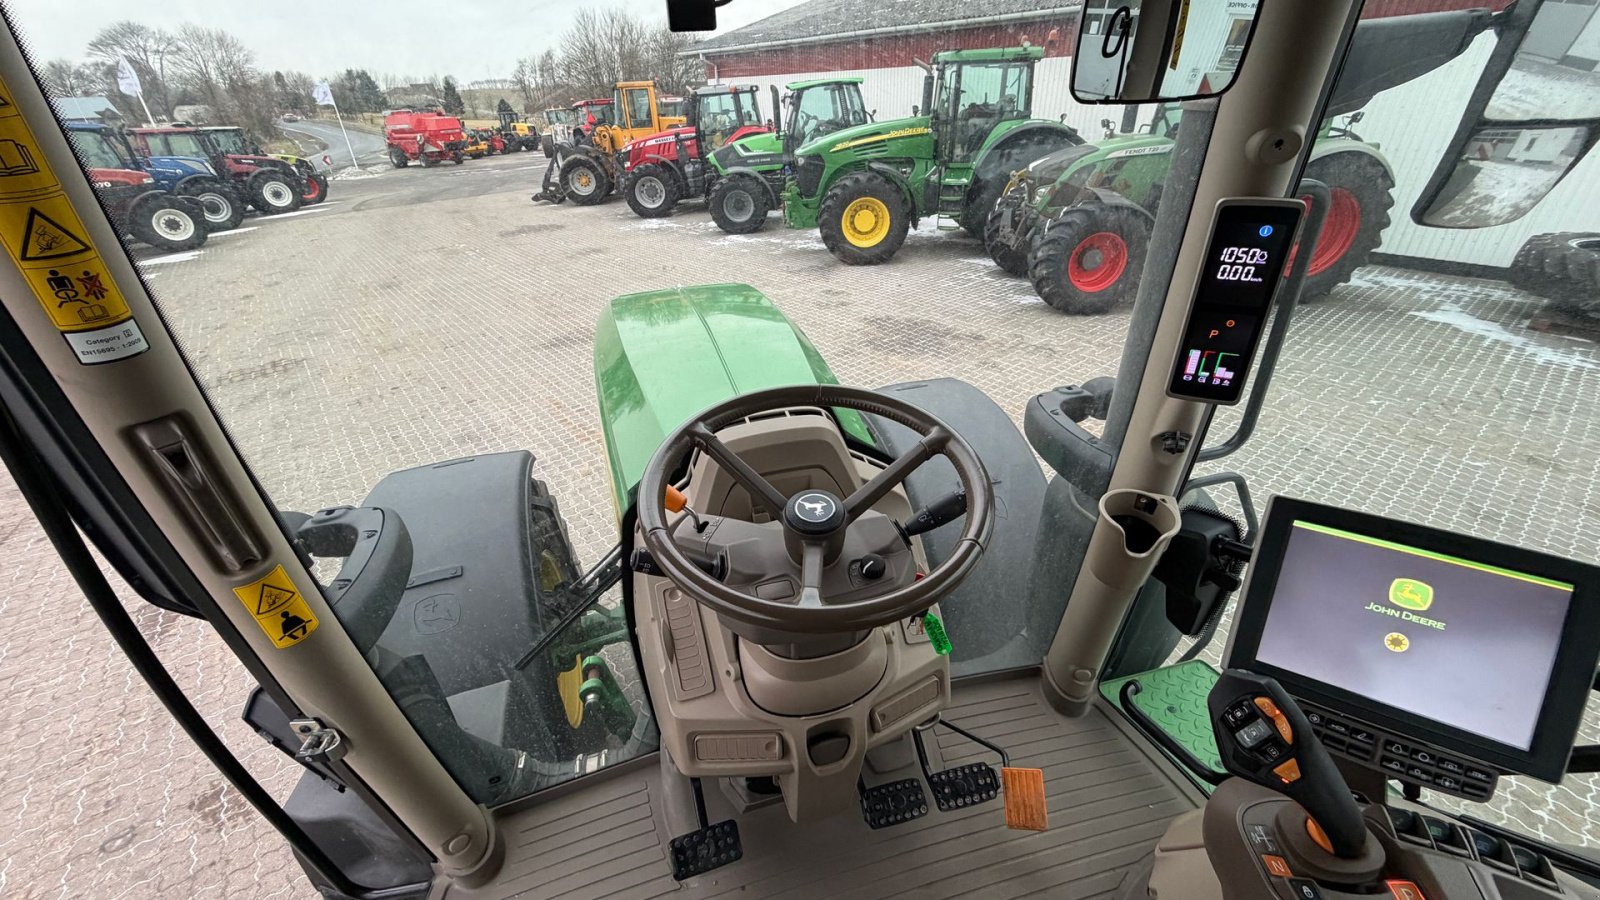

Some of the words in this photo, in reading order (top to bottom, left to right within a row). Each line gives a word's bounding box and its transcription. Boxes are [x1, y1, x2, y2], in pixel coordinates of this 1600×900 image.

[1220, 247, 1260, 264] 1050
[1217, 264, 1255, 281] 0.00
[86, 334, 121, 346] Category
[1209, 329, 1219, 339] P
[1364, 601, 1401, 618] JOHN
[1401, 610, 1447, 630] DEERE
